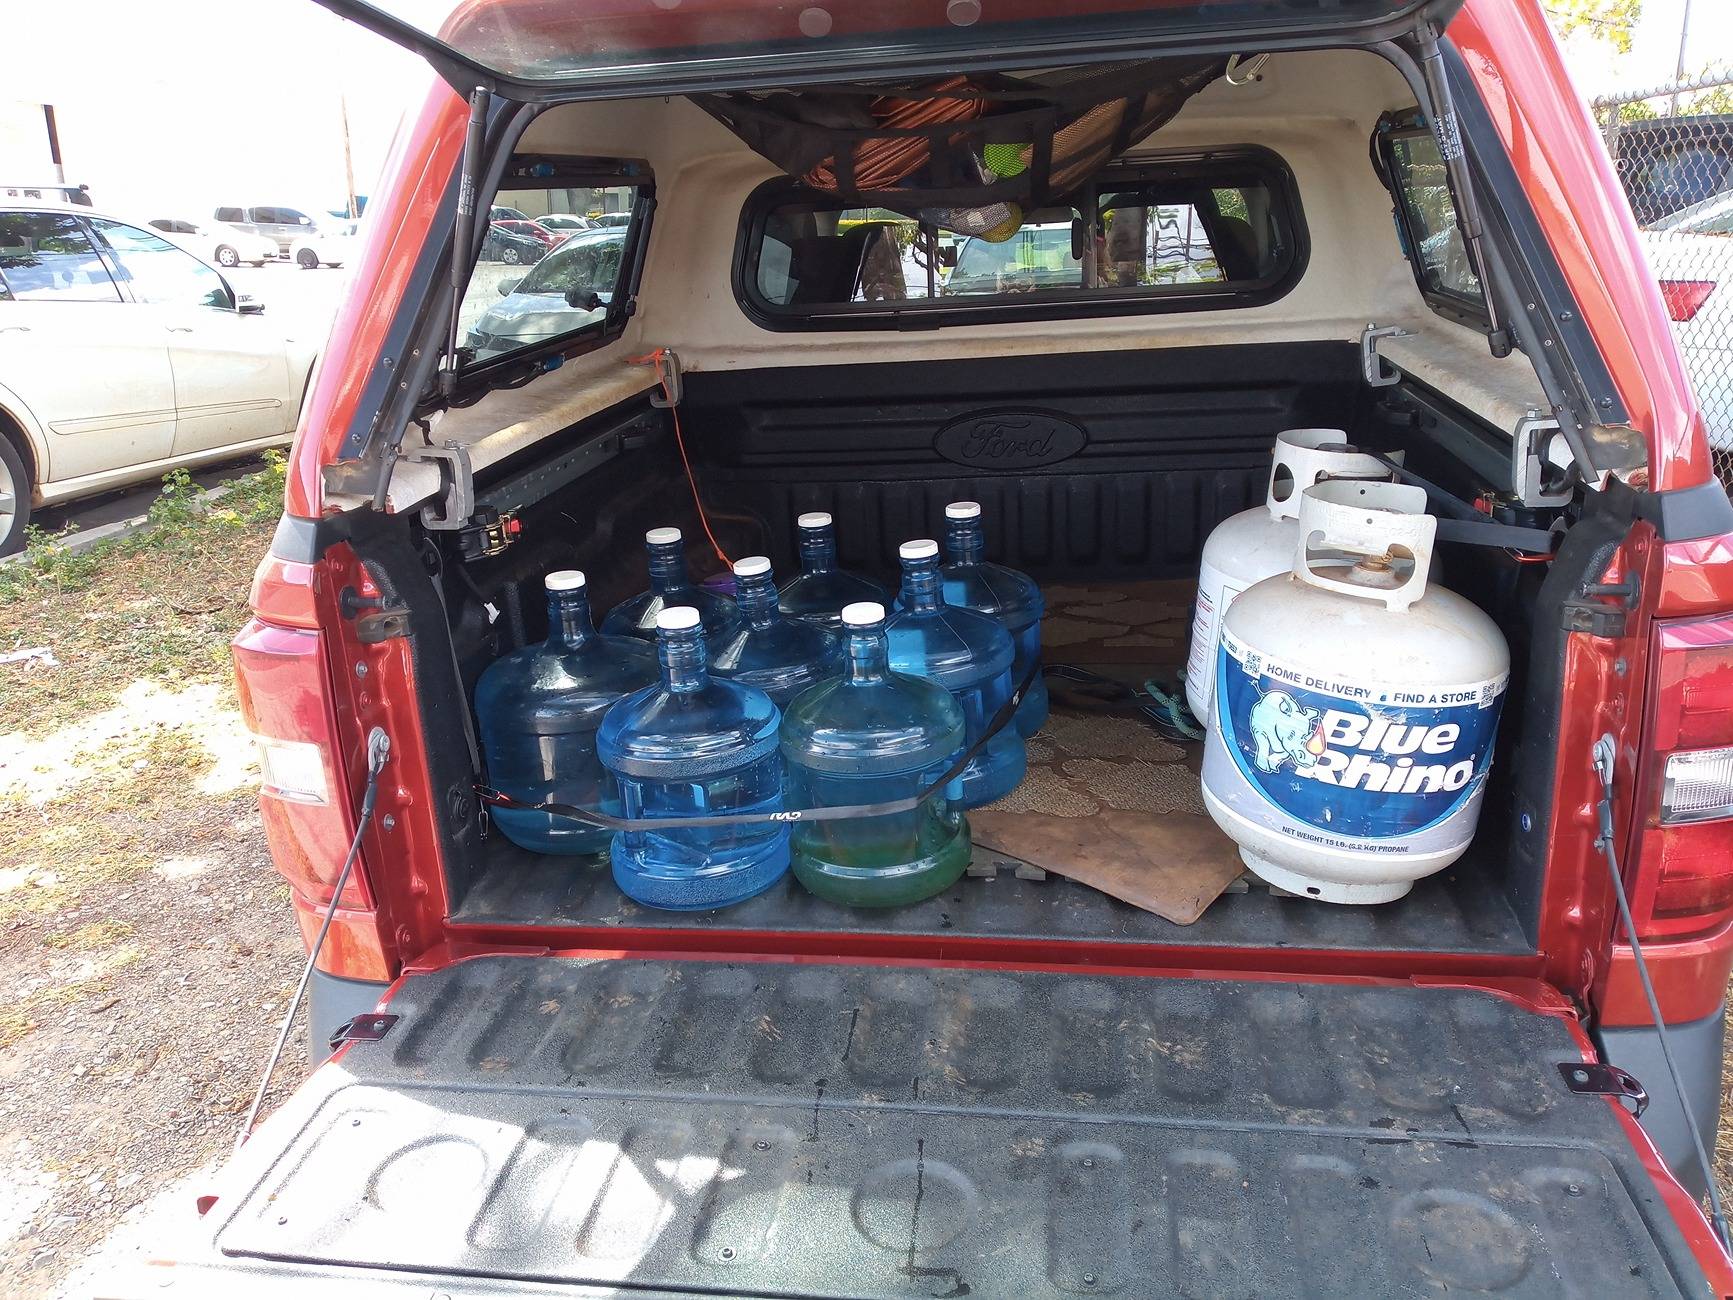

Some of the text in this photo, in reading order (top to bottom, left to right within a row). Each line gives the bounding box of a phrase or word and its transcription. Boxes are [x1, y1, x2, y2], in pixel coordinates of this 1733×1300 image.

[961, 420, 1056, 459] Ford
[1266, 663, 1372, 699] HOME DELIVERY
[1393, 690, 1478, 704] FIND A STORE
[1321, 708, 1461, 755] Blue
[1294, 749, 1474, 794] Rhino
[1281, 825, 1296, 836] NET
[1296, 829, 1325, 844] WEIGHT
[1377, 845, 1410, 854] PROPANE
